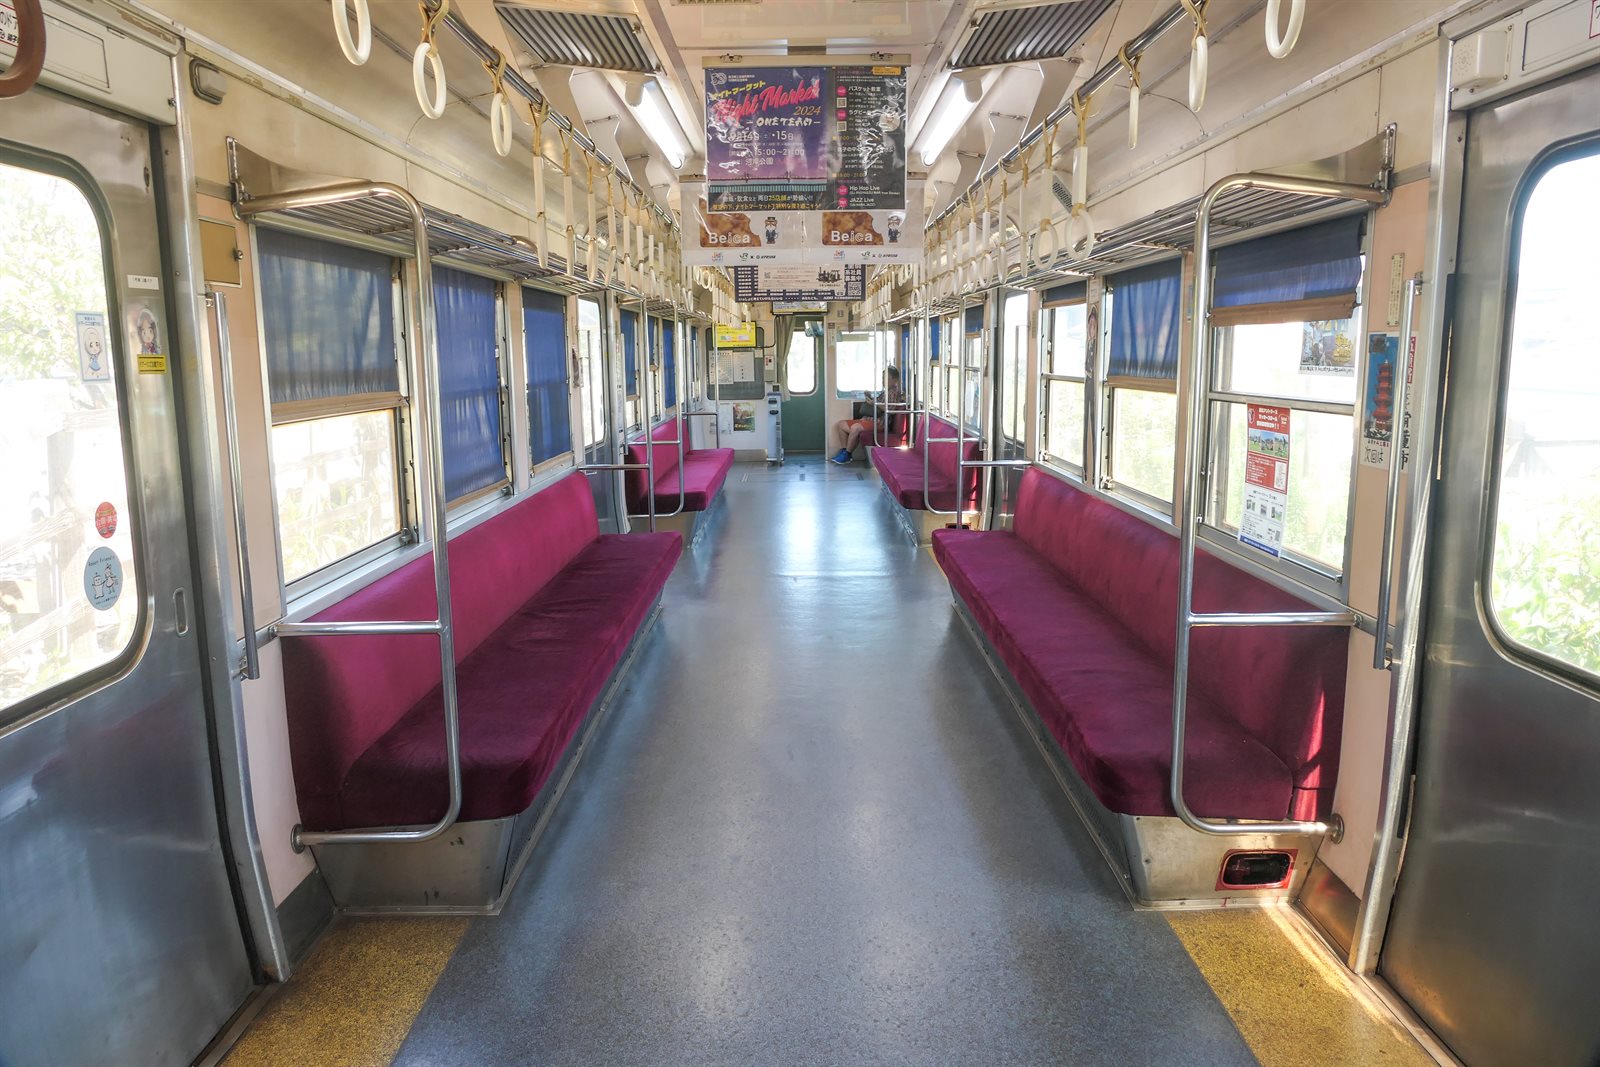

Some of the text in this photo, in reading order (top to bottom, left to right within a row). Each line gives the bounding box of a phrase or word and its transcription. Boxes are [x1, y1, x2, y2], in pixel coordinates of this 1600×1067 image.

[759, 79, 820, 112] Market
[793, 105, 822, 116] 2024
[756, 117, 813, 127] ONE TEAM
[709, 233, 750, 244] Beica
[831, 230, 873, 242] Beica
